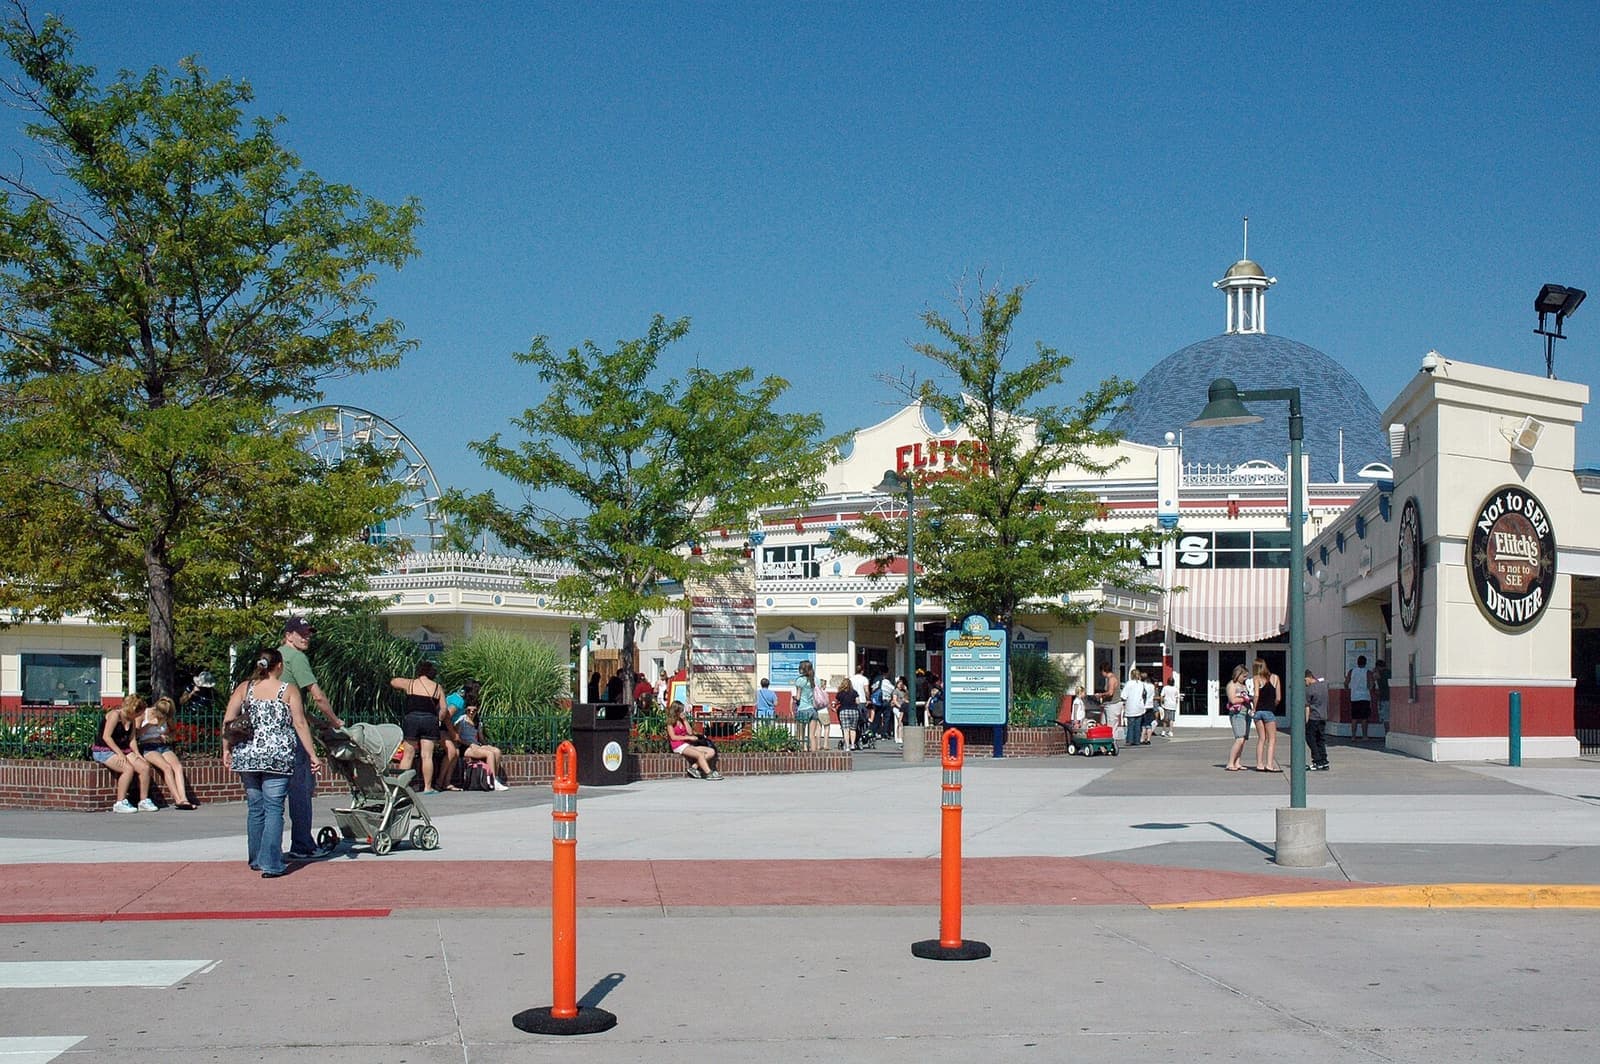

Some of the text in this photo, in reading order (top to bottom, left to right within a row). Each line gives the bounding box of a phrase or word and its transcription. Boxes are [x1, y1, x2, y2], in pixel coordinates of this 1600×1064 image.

[1524, 499, 1549, 539] SEE
[1494, 531, 1538, 564] Elitch's
[1504, 575, 1523, 586] SEE
[1507, 564, 1521, 574] not
[1522, 564, 1530, 575] to
[1486, 581, 1543, 622] DENVER
